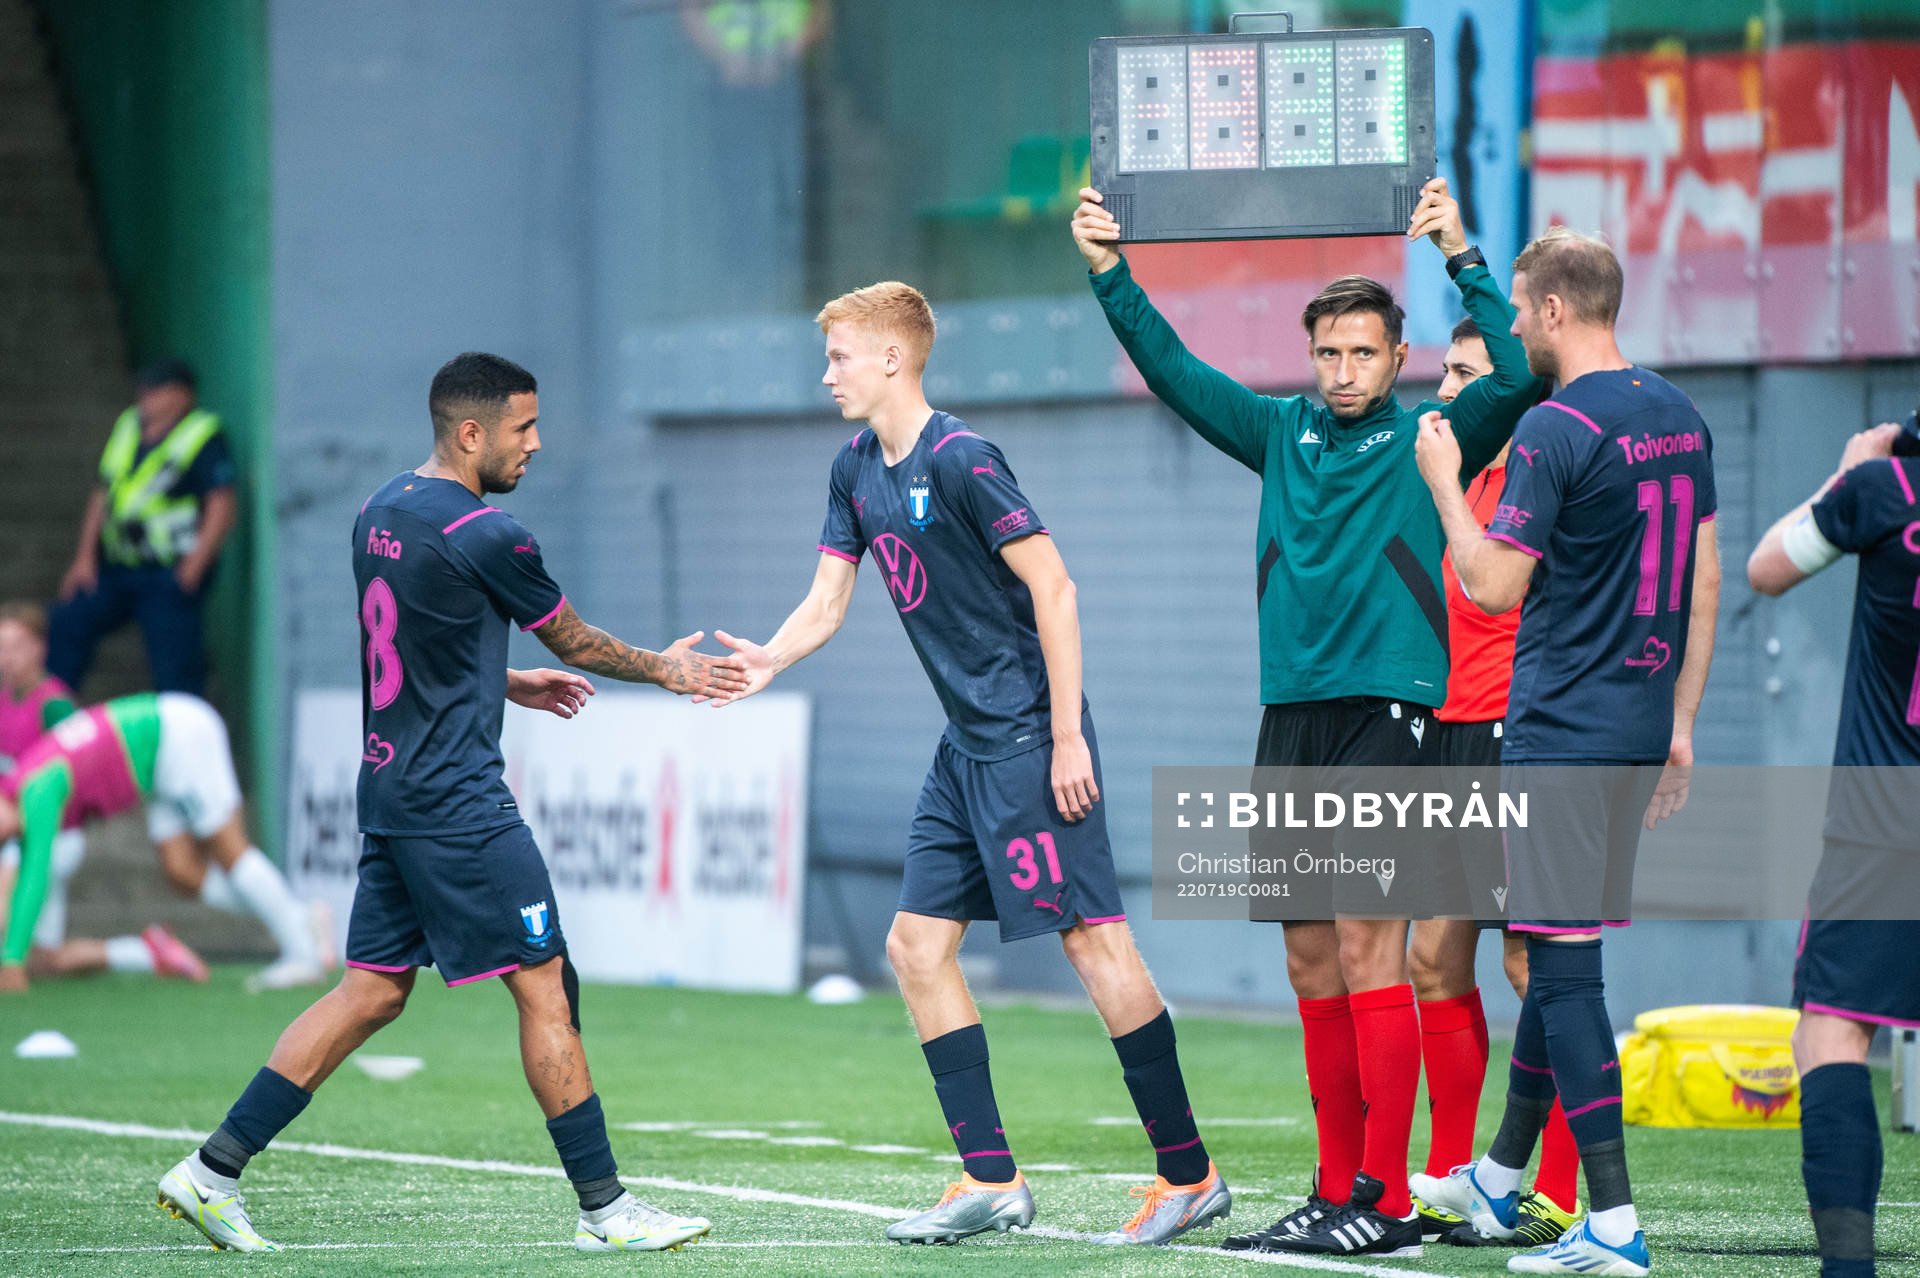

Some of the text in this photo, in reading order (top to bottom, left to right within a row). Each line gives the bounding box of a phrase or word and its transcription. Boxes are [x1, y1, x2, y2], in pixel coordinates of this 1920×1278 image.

[1356, 430, 1395, 453] UEFA
[1616, 431, 1703, 465] Toivonen
[366, 526, 402, 560] Peña
[1633, 474, 1694, 616] 11
[362, 576, 404, 711] 8
[1006, 831, 1063, 891] 31
